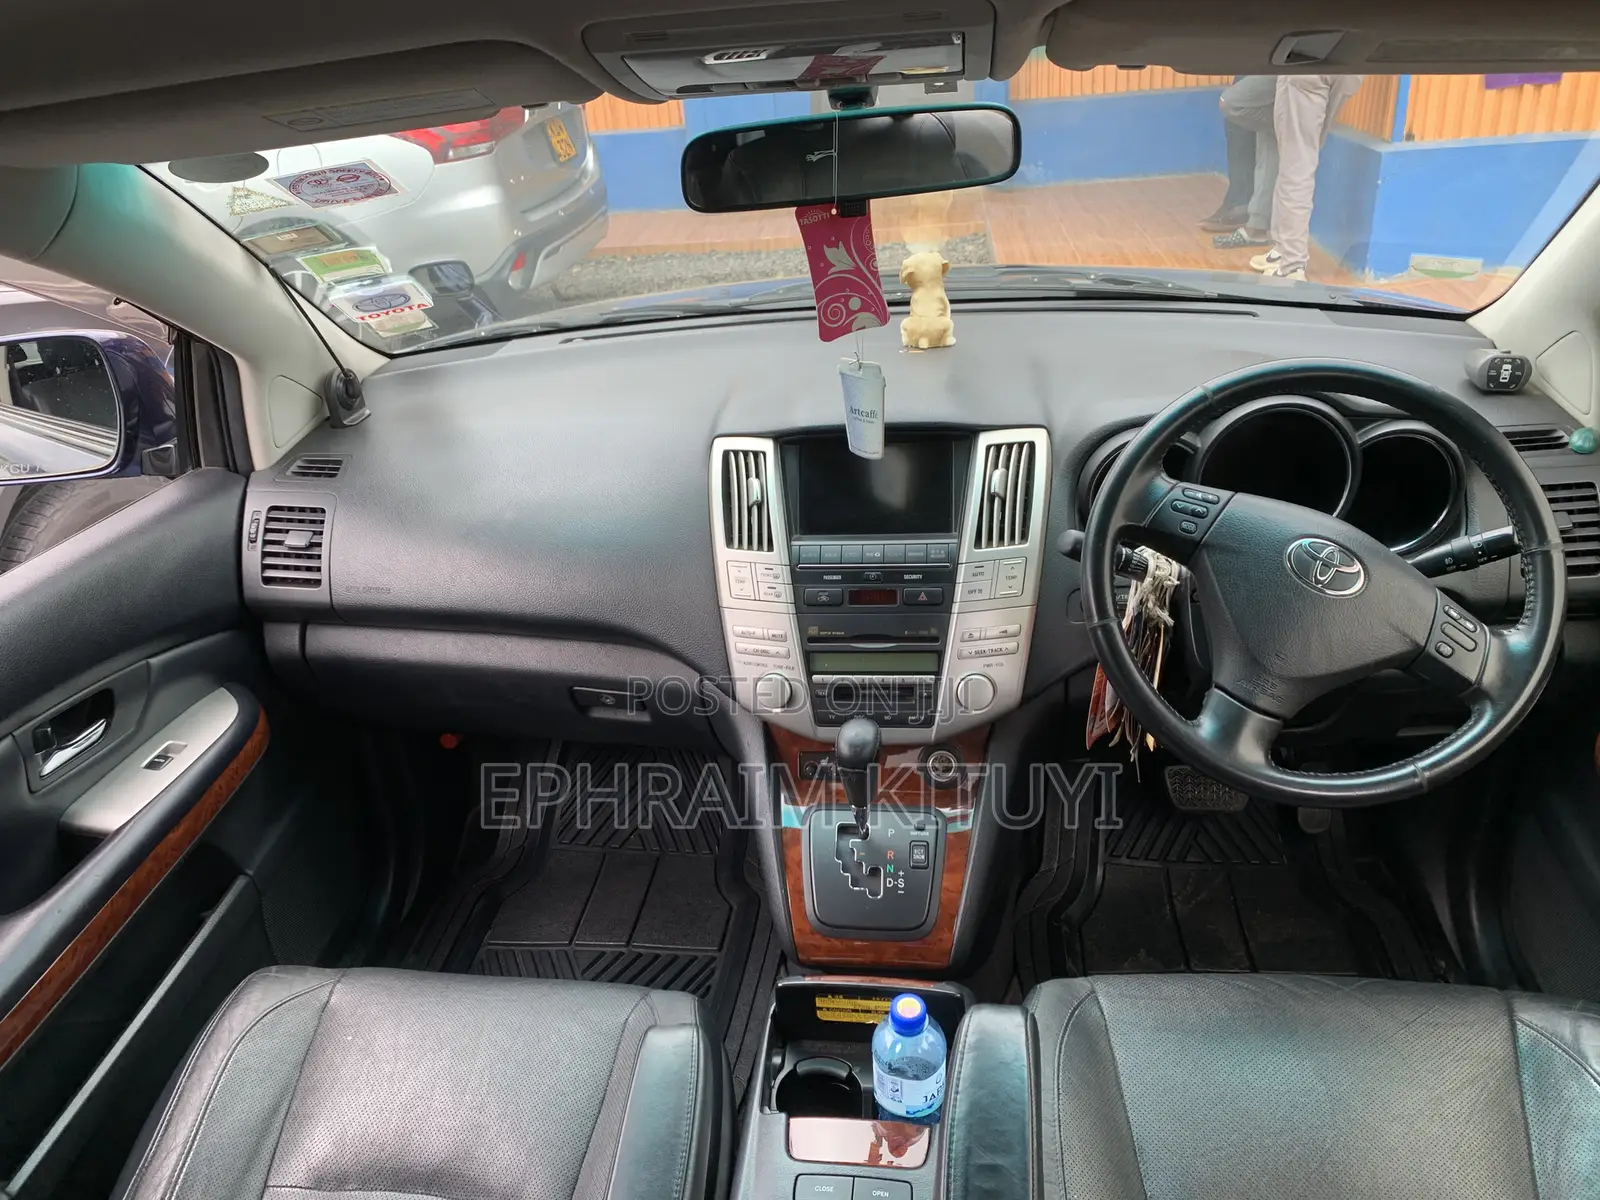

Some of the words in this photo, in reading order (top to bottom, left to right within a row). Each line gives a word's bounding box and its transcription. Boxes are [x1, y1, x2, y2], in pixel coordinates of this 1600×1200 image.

[800, 212, 830, 225] TASOTTI
[356, 303, 429, 321] TOYOTA
[888, 829, 895, 837] P
[887, 851, 894, 859] R
[887, 864, 894, 873] N
